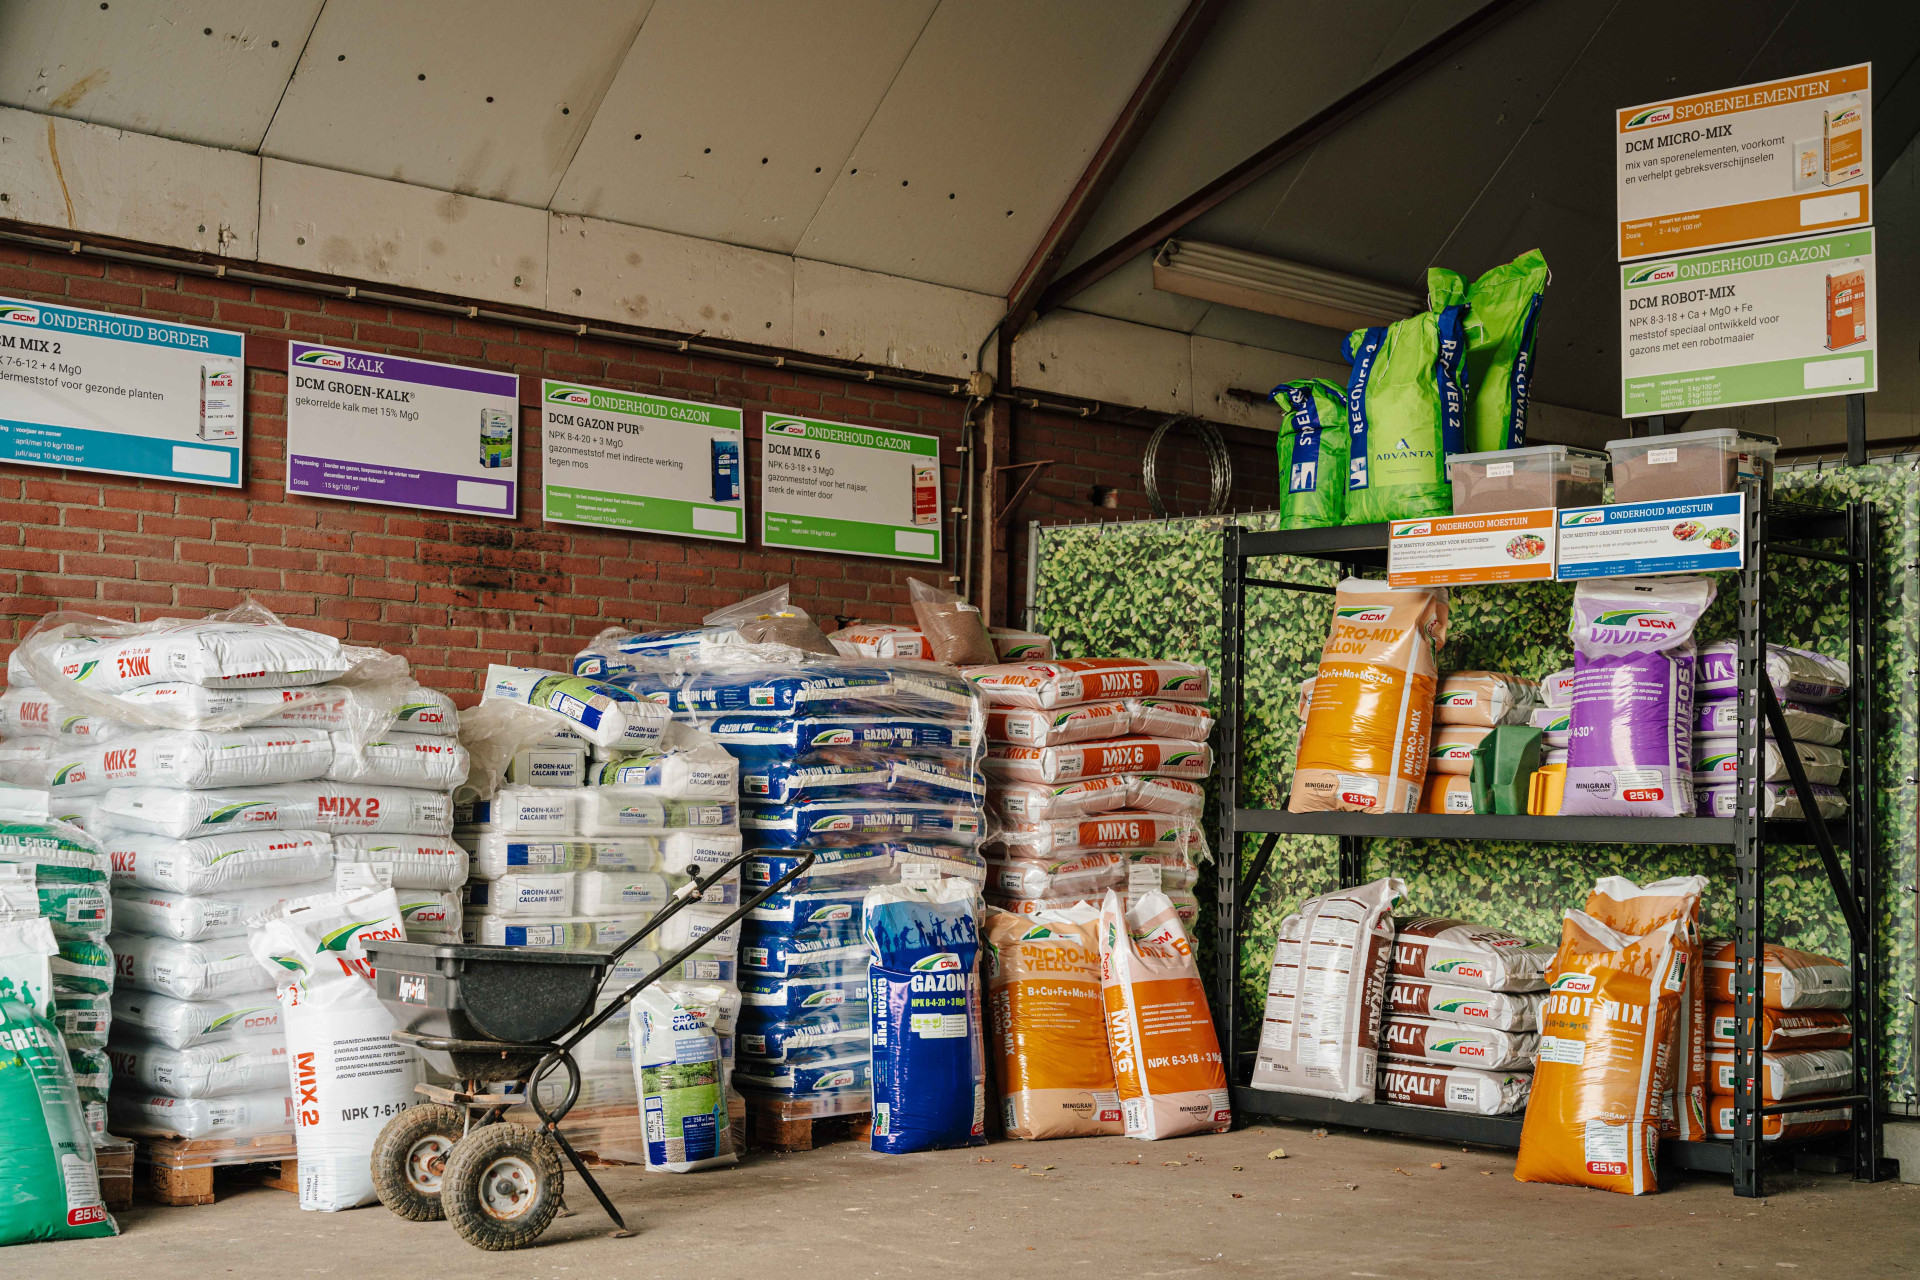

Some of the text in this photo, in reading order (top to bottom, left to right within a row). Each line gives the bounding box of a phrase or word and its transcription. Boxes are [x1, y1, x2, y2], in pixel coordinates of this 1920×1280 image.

[1677, 80, 1830, 120] SPORENELEMENTEN
[1651, 113, 1670, 122] DCM
[1625, 124, 1732, 154] DCM MICRO-MIX
[1625, 136, 1785, 170] mix van sporenelementen, voorkomt
[1625, 152, 1774, 185] en verhelpt gebreksverschijnselen
[1680, 244, 1831, 278] ONDERHOUD GAZON
[1629, 285, 1735, 311] DCM ROBOT-MIX
[13, 313, 36, 323] DCM
[1629, 303, 1752, 327] NPK 8-3-18 MgO Fe
[42, 312, 209, 348] ONDERHOUD BORDER
[1630, 314, 1779, 341] meststof speciaal ontwikkeld voor
[20, 337, 49, 353] MIX
[53, 343, 61, 354] 2
[1630, 332, 1754, 358] gazons met een robotmaaier
[6, 356, 82, 376] 7-6-12 MgO
[322, 359, 342, 367] DCM
[347, 357, 384, 374] KALK
[61, 380, 82, 390] voor
[85, 383, 126, 396] gezonde
[129, 388, 164, 400] planten
[296, 376, 325, 391] DCM
[296, 396, 419, 421] gekorrelde kalk met 15% MgO
[571, 396, 588, 404] DCM
[593, 395, 710, 423] ONDERHOUD GAZON
[549, 413, 574, 426] DCM
[577, 416, 614, 431] GAZON
[549, 431, 623, 449] NPK 8-4-20 MgO
[807, 426, 911, 451] ONDERHOUD GAZON
[549, 444, 683, 470] gazonmeststof met indirecte werking
[768, 443, 821, 460] DCM MIX 6
[1376, 450, 1432, 461] ADVANTA
[549, 457, 589, 469] tegen mos
[768, 461, 834, 476] NPK 6-3-18 MgO
[768, 474, 867, 493] gazonmeststof voor het najaar,
[768, 485, 833, 499] sterk winter door
[1610, 503, 1713, 519] ONDERHOUD MOESTUIN
[1436, 517, 1528, 531] ONDERHOUD MOESTUIN
[1360, 613, 1386, 621] DCM
[1638, 619, 1676, 630] DCM
[1002, 675, 1025, 686] MIX
[1101, 673, 1143, 691] MIX 6
[20, 702, 40, 721] MIX
[863, 729, 892, 741] GAZON
[1403, 709, 1422, 775] MICRO-MIX
[104, 749, 136, 771] MIX 2
[1103, 747, 1144, 766] MIX 6
[1413, 735, 1425, 777] YELLOW
[318, 797, 380, 817] MIX 2
[1349, 794, 1359, 803] 25
[863, 814, 893, 826] GAZON
[1098, 823, 1139, 840] MIX 6
[519, 895, 546, 903] CALCAIRE
[1171, 938, 1191, 956] 6
[1025, 960, 1087, 973] YELLOW
[1458, 967, 1483, 978] DCM
[911, 973, 965, 992] GAZON
[1567, 981, 1591, 991] DCM
[876, 978, 887, 1018] GAZON
[911, 998, 946, 1008] NPK 8-4-20
[993, 993, 1002, 1034] YELLOW
[1463, 1007, 1489, 1018] DCM
[1000, 990, 1015, 1056] MICRO-MIX
[1112, 1010, 1134, 1074] MIX 6
[1459, 1046, 1484, 1056] DCM
[1148, 1053, 1198, 1068] NPK 6-3-18
[1650, 1042, 1666, 1116] ROBOT-MIX
[297, 1052, 320, 1126] MIX 2
[342, 1106, 368, 1122] NPK
[1592, 1162, 1607, 1172] 25
[75, 1210, 91, 1221] 25
